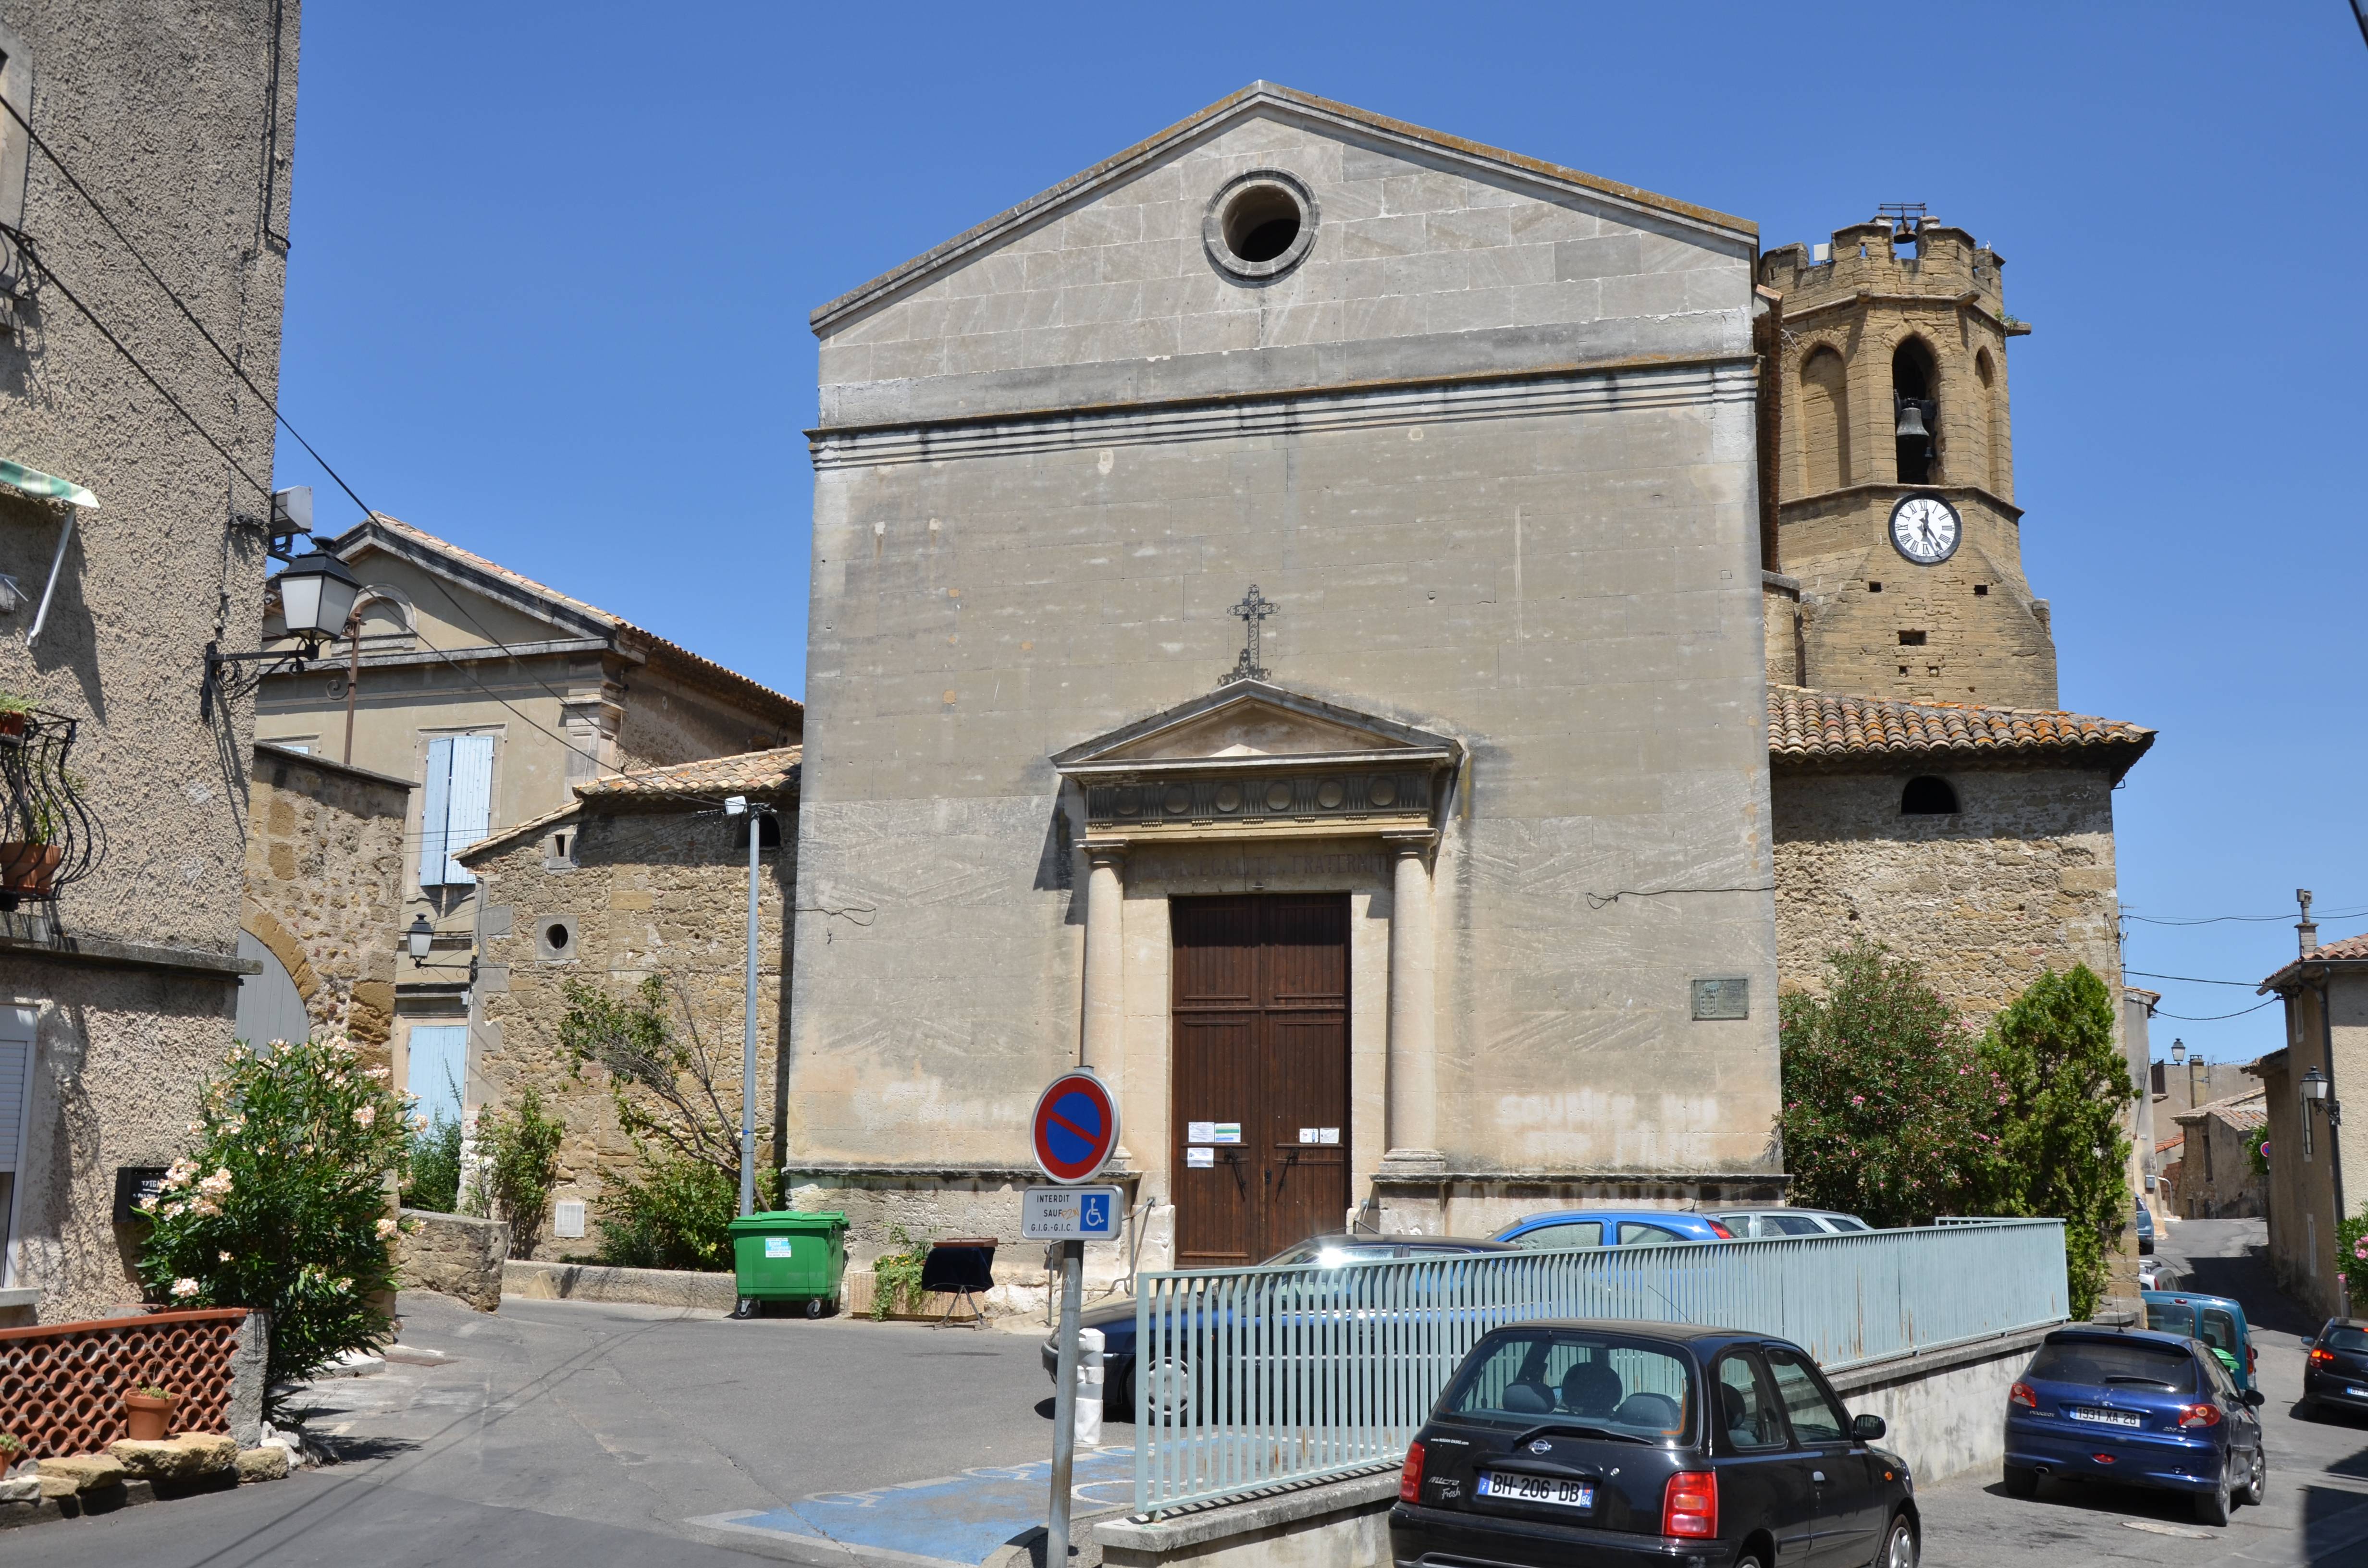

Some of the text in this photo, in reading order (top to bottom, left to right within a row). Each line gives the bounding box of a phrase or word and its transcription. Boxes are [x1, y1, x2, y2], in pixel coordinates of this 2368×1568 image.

[1036, 1194, 1070, 1202] INTERDIT
[1043, 1209, 1062, 1217] SAUF
[2077, 1407, 2137, 1425] 1931 XA 28
[1442, 1486, 1461, 1499] Fresh
[1581, 1495, 1591, 1506] 84
